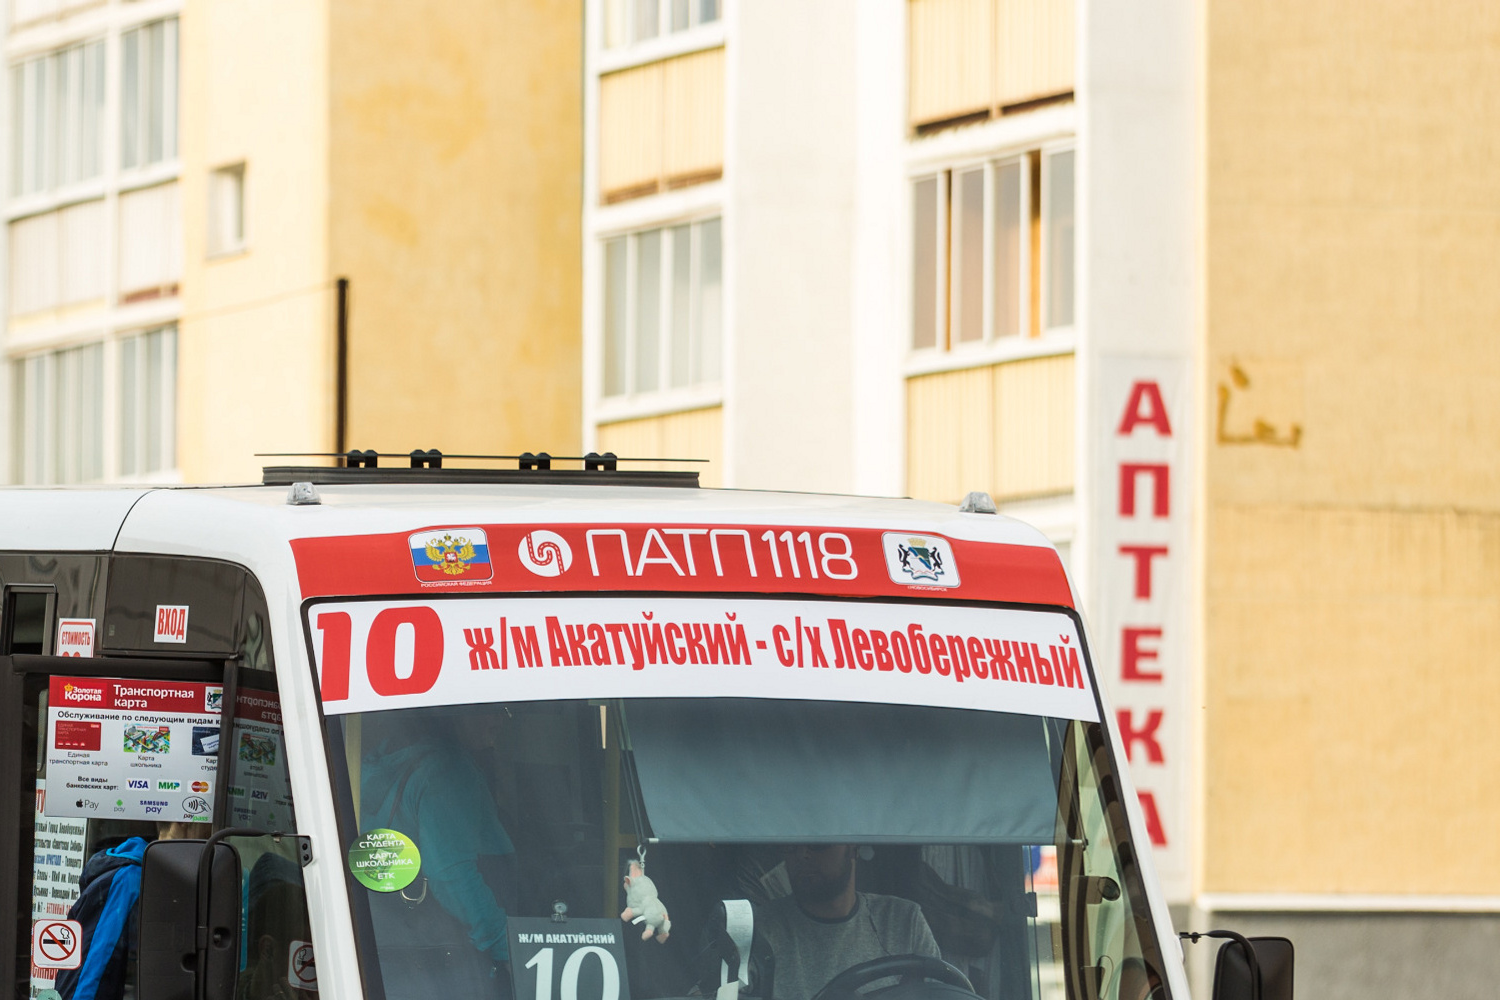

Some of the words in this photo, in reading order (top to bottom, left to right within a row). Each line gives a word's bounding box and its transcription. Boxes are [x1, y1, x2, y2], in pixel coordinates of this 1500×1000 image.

[157, 608, 186, 640] ВХОД
[61, 631, 91, 646] СТОИМОСТЬ
[317, 605, 445, 702] 10
[463, 616, 543, 671] ж/м
[545, 611, 752, 671] Акатуйский
[772, 616, 829, 668] с/х
[827, 618, 1085, 690] Левобережный
[73, 686, 102, 694] Золотая
[113, 684, 194, 699] Транспортная
[64, 690, 102, 702] Корона
[114, 698, 148, 709] карта
[58, 711, 120, 721] Обслуживание
[134, 715, 184, 724] следующим
[137, 755, 155, 763] Карта
[128, 780, 149, 789] VISA
[159, 781, 181, 790] МИР
[85, 799, 99, 811] Pay
[145, 806, 162, 814] pay
[366, 833, 396, 841] КАРТА
[359, 840, 405, 848] СТУДЕНТА
[369, 852, 398, 860] КАРТА
[356, 858, 413, 868] ШКОЛЬНИКА
[377, 872, 395, 880] ЕТК
[518, 933, 544, 943] Ж/М
[546, 932, 616, 944] АКАТУЙСКИЙ
